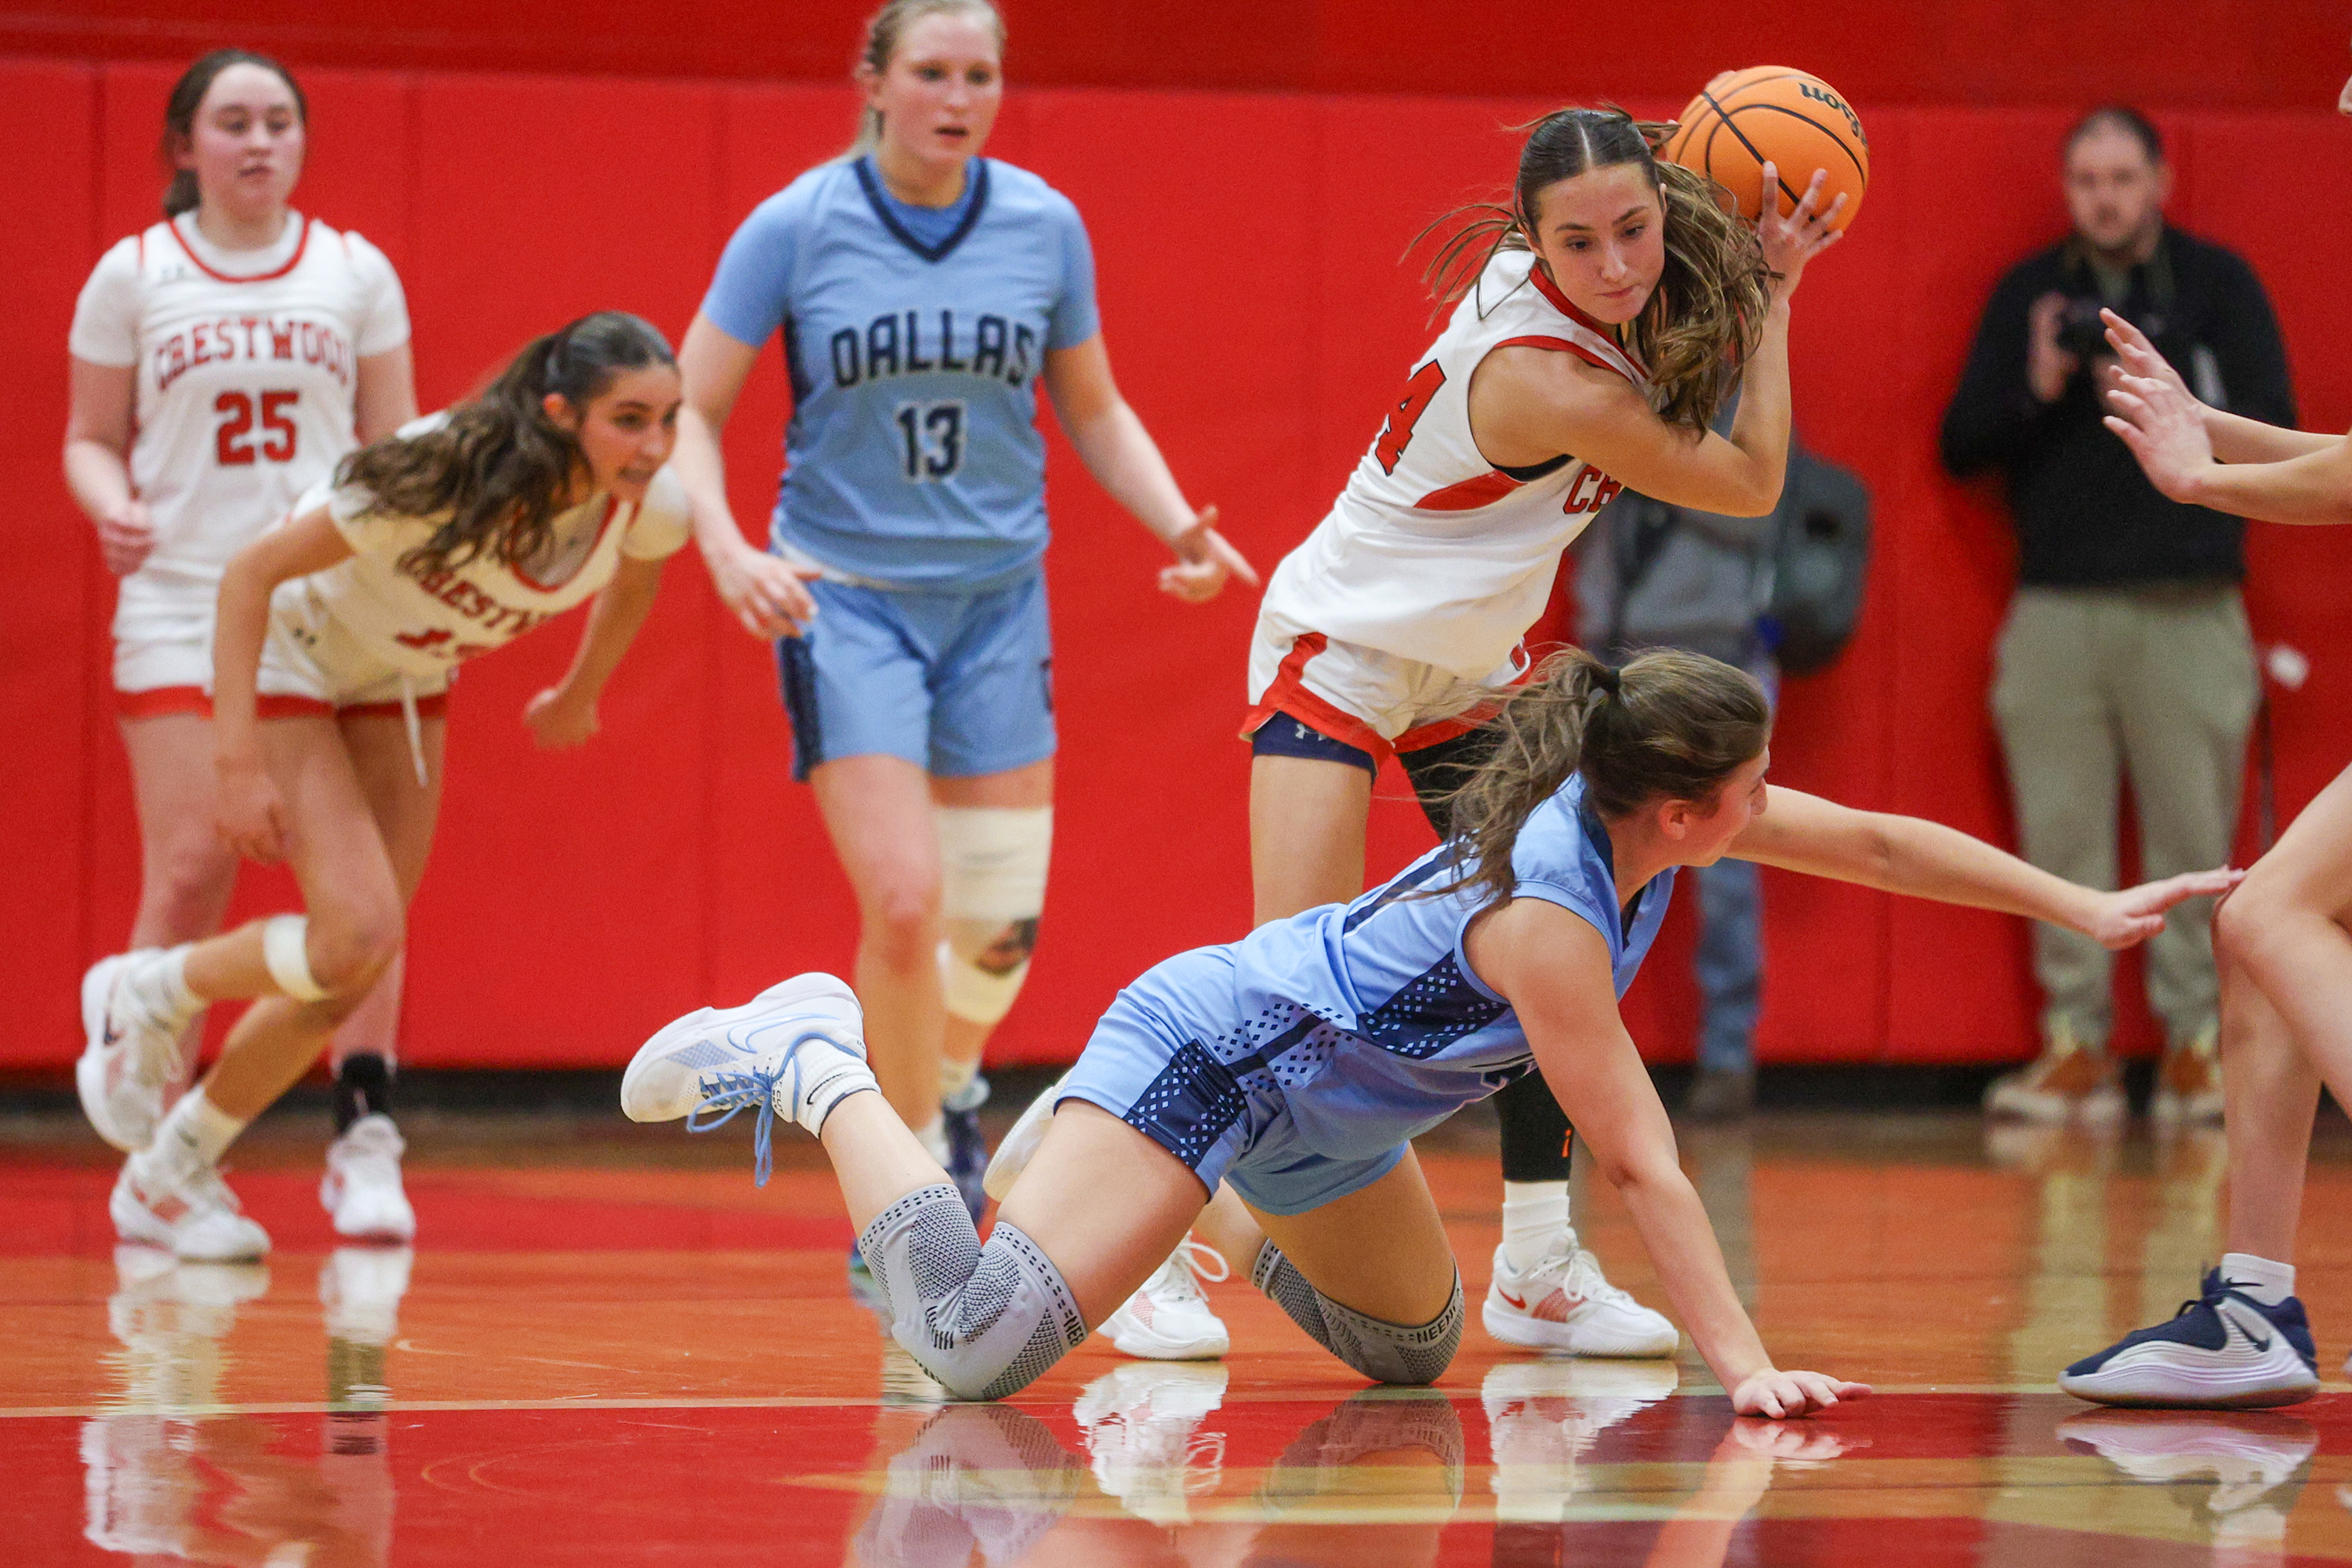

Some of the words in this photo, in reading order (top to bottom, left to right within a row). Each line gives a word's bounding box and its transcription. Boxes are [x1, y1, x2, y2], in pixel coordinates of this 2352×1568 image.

[830, 309, 1036, 390] DALLAS
[213, 389, 299, 466] 25
[895, 402, 964, 480] 13
